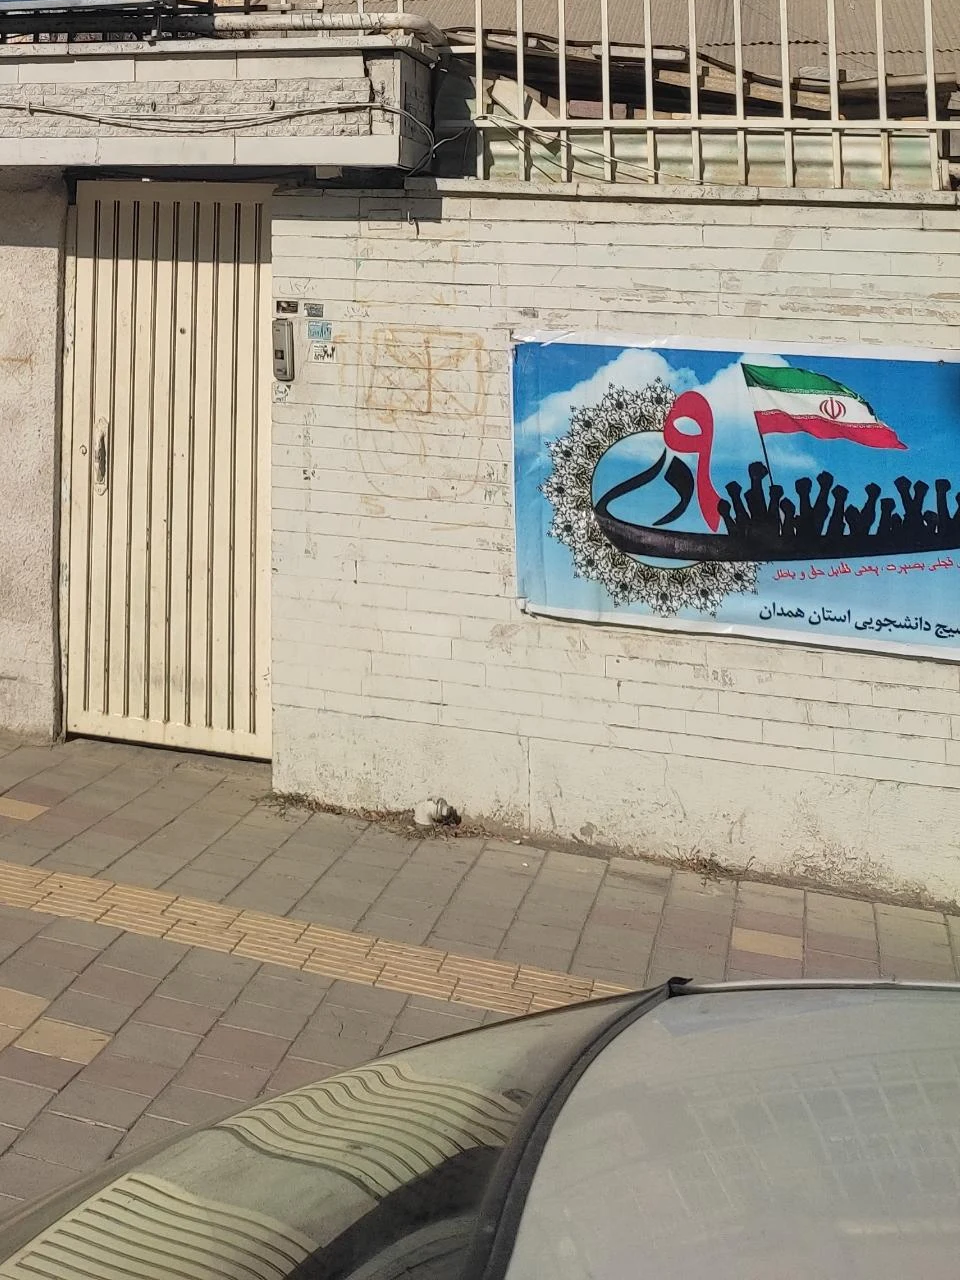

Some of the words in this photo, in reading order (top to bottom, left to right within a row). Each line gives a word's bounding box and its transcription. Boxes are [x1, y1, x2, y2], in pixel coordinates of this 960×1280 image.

[772, 568, 796, 581] باطل
[799, 571, 806, 581] و
[808, 564, 826, 580] حق
[759, 602, 805, 620] همدان
[807, 607, 851, 626] استان
[854, 615, 932, 633] دانشجویی
[934, 622, 960, 639] سیج
